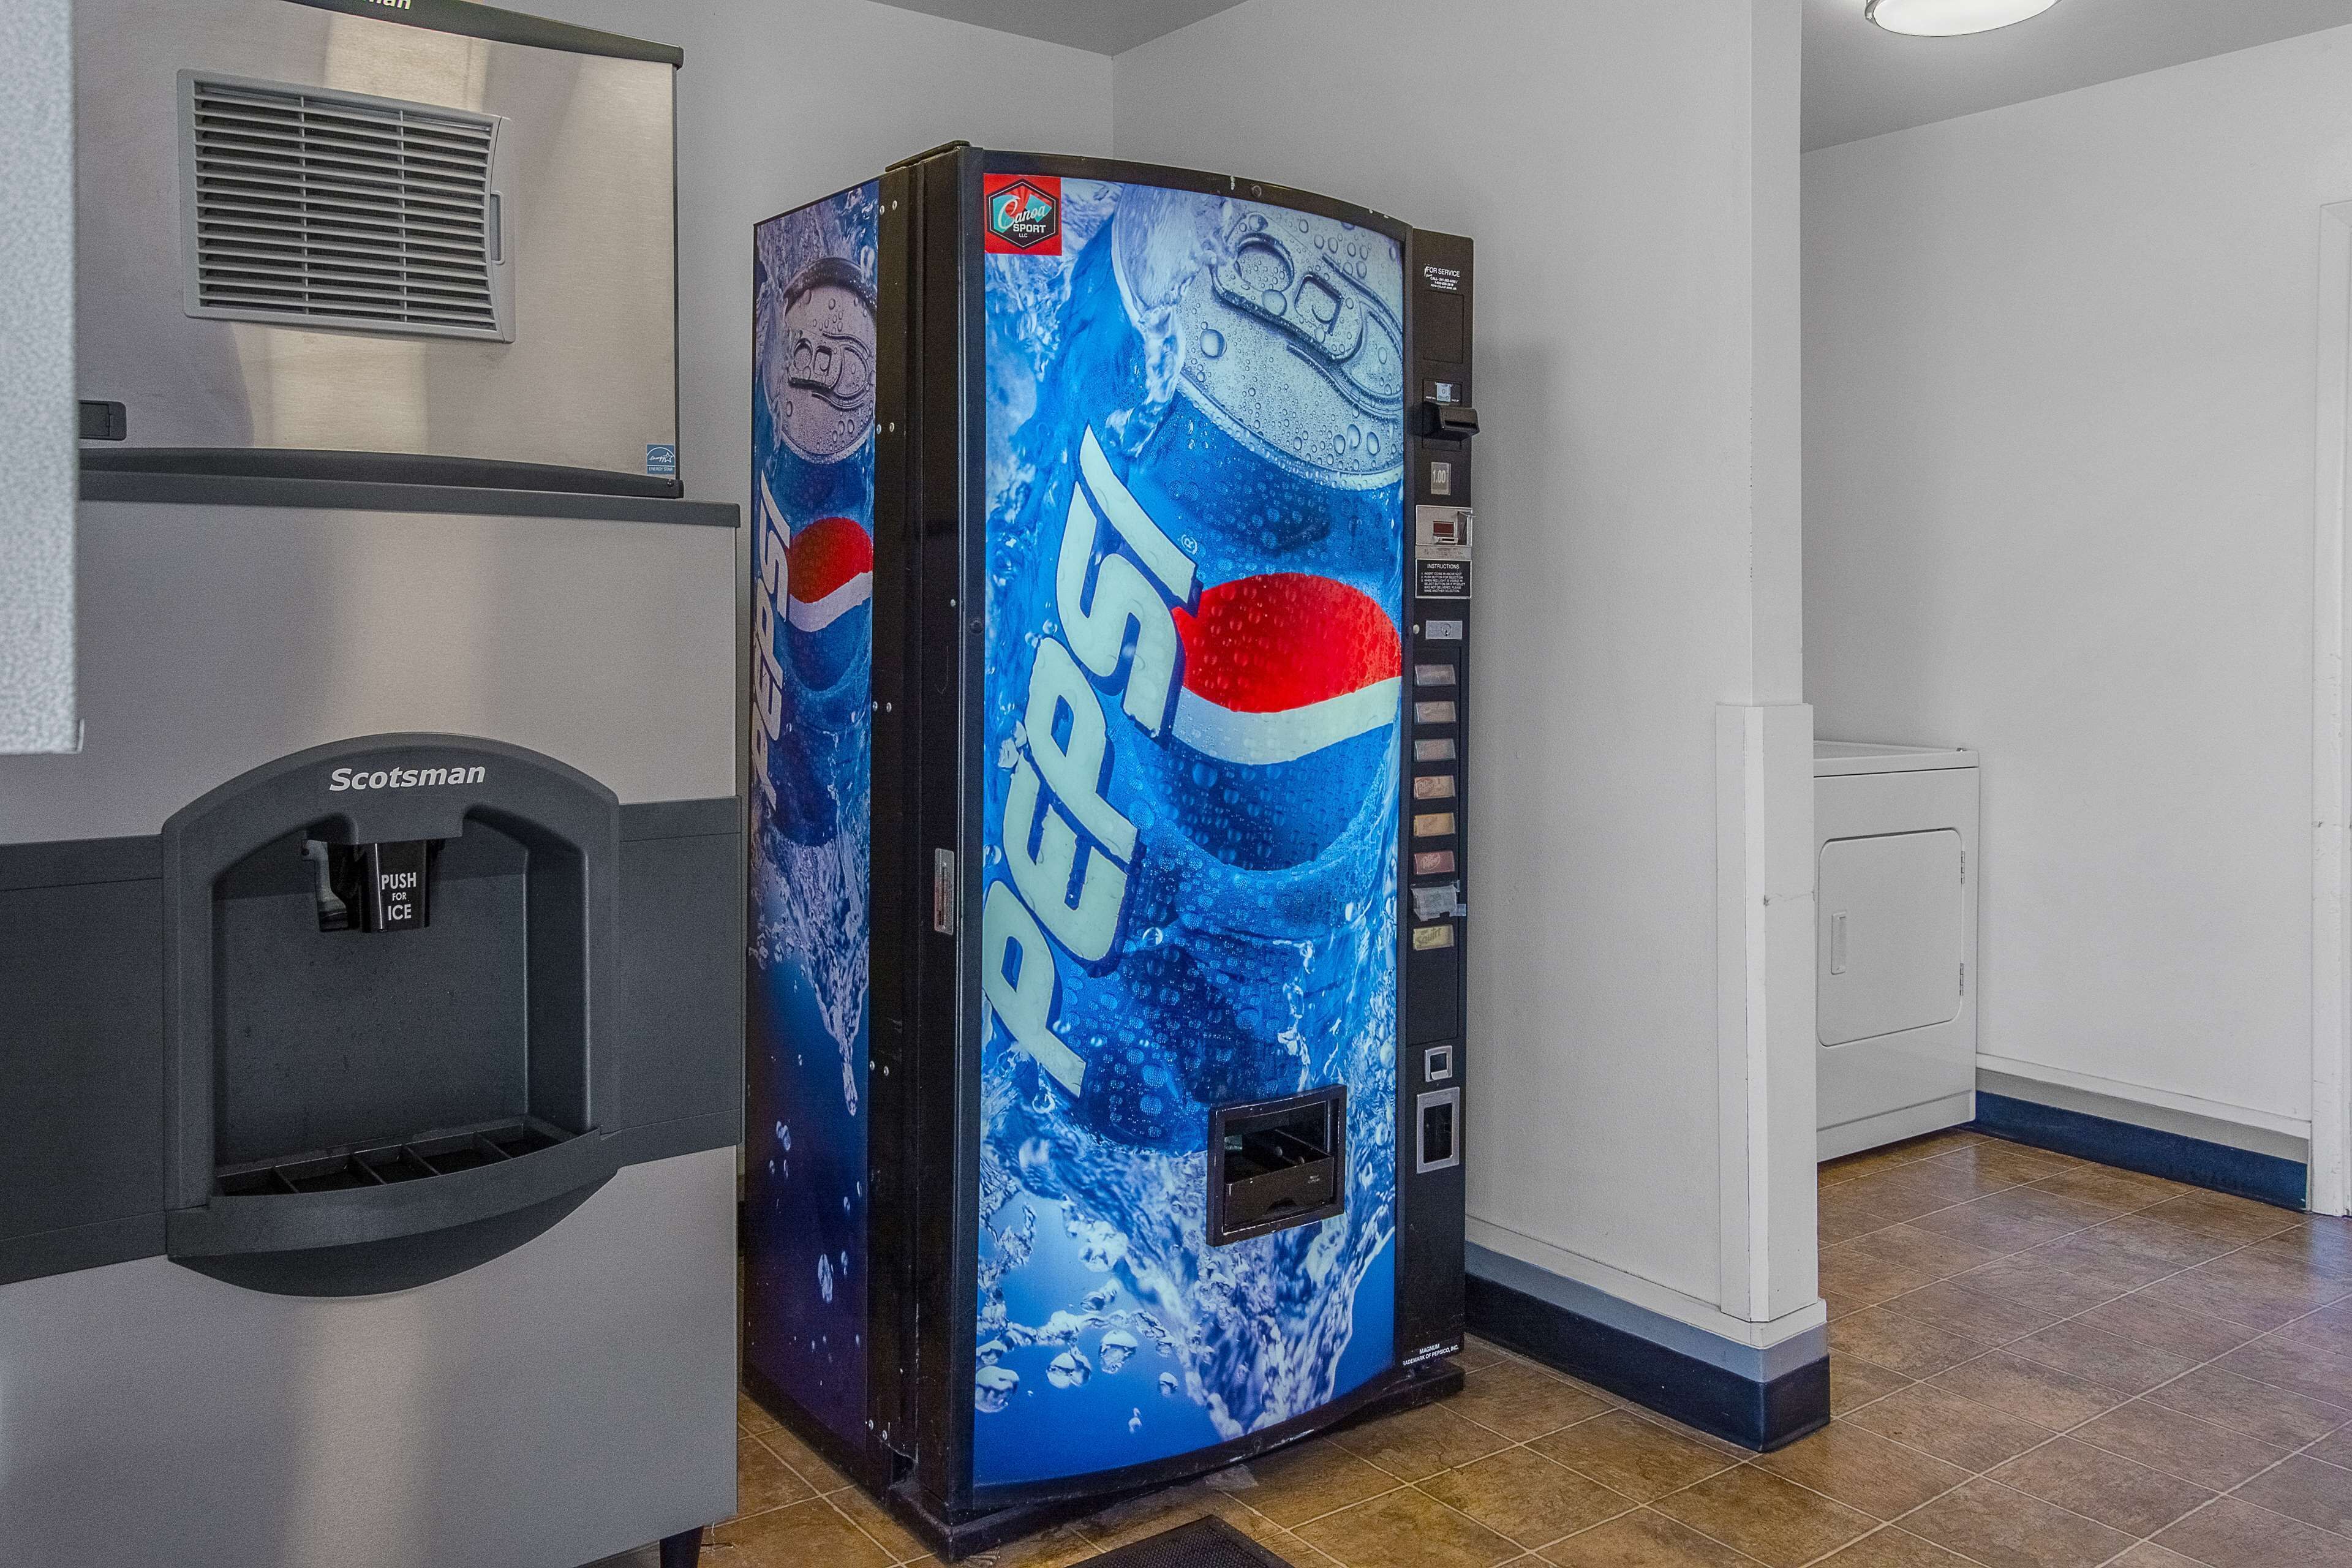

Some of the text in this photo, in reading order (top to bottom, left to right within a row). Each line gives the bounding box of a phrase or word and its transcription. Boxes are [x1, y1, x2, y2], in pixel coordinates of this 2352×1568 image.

[998, 197, 1047, 230] Canoa
[1013, 224, 1046, 233] SPORT
[1425, 266, 1460, 277] FOR SERVICE
[1432, 469, 1446, 483] 1.00
[750, 469, 791, 812] PEPSI
[982, 423, 1197, 1098] PEPSI
[329, 766, 486, 792] Scotsman
[381, 872, 417, 890] PUSH
[392, 892, 407, 901] FOR
[388, 903, 412, 921] ICE
[1419, 1343, 1440, 1355] MAGNUM
[1432, 1347, 1450, 1357] PEPSICO,
